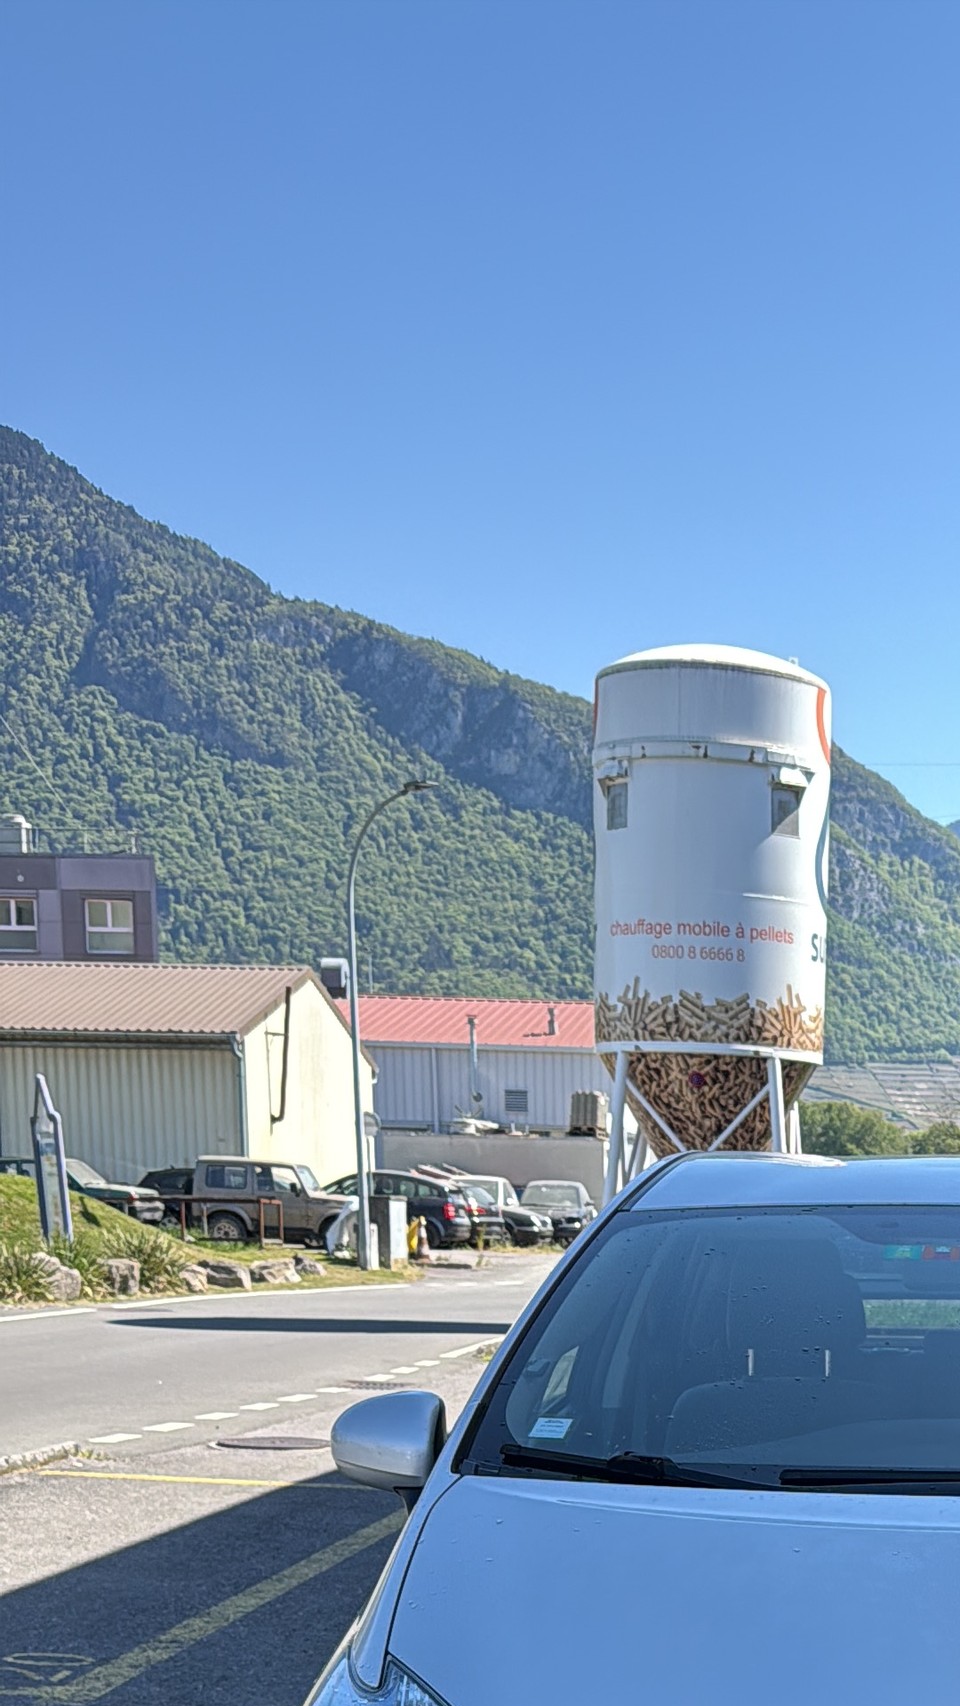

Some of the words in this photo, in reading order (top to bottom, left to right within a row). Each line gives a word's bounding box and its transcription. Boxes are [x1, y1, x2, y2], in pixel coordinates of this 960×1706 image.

[610, 918, 672, 939] chauffage
[677, 921, 730, 938] mobile
[735, 922, 745, 939] à
[750, 926, 794, 944] pellets
[651, 944, 684, 959] 0800
[688, 945, 697, 960] 8
[700, 946, 733, 962] 6666
[736, 947, 746, 963] 8
